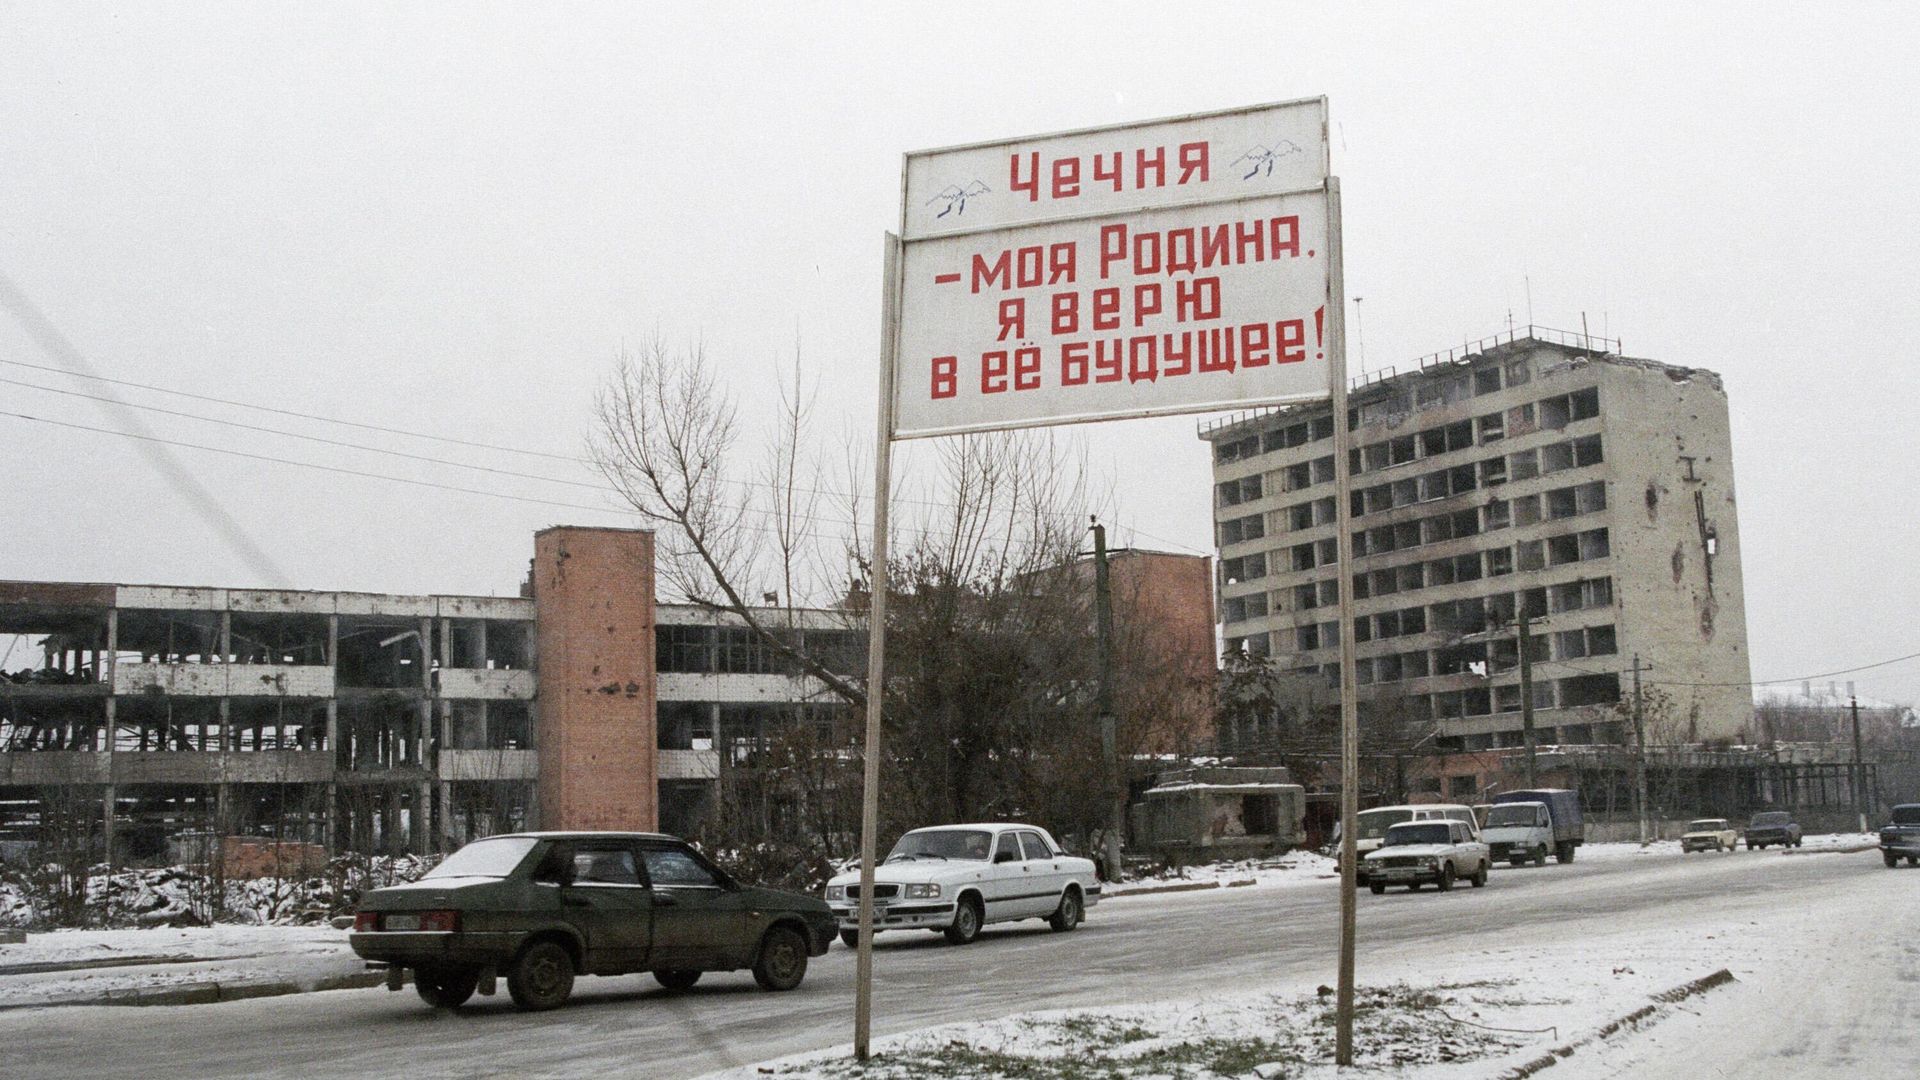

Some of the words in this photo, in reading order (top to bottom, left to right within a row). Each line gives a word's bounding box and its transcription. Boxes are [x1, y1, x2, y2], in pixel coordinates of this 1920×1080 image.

[1010, 142, 1209, 203] Чечня
[1051, 276, 1221, 336] верю
[981, 341, 1041, 395] её
[1061, 305, 1325, 387] будущее!
